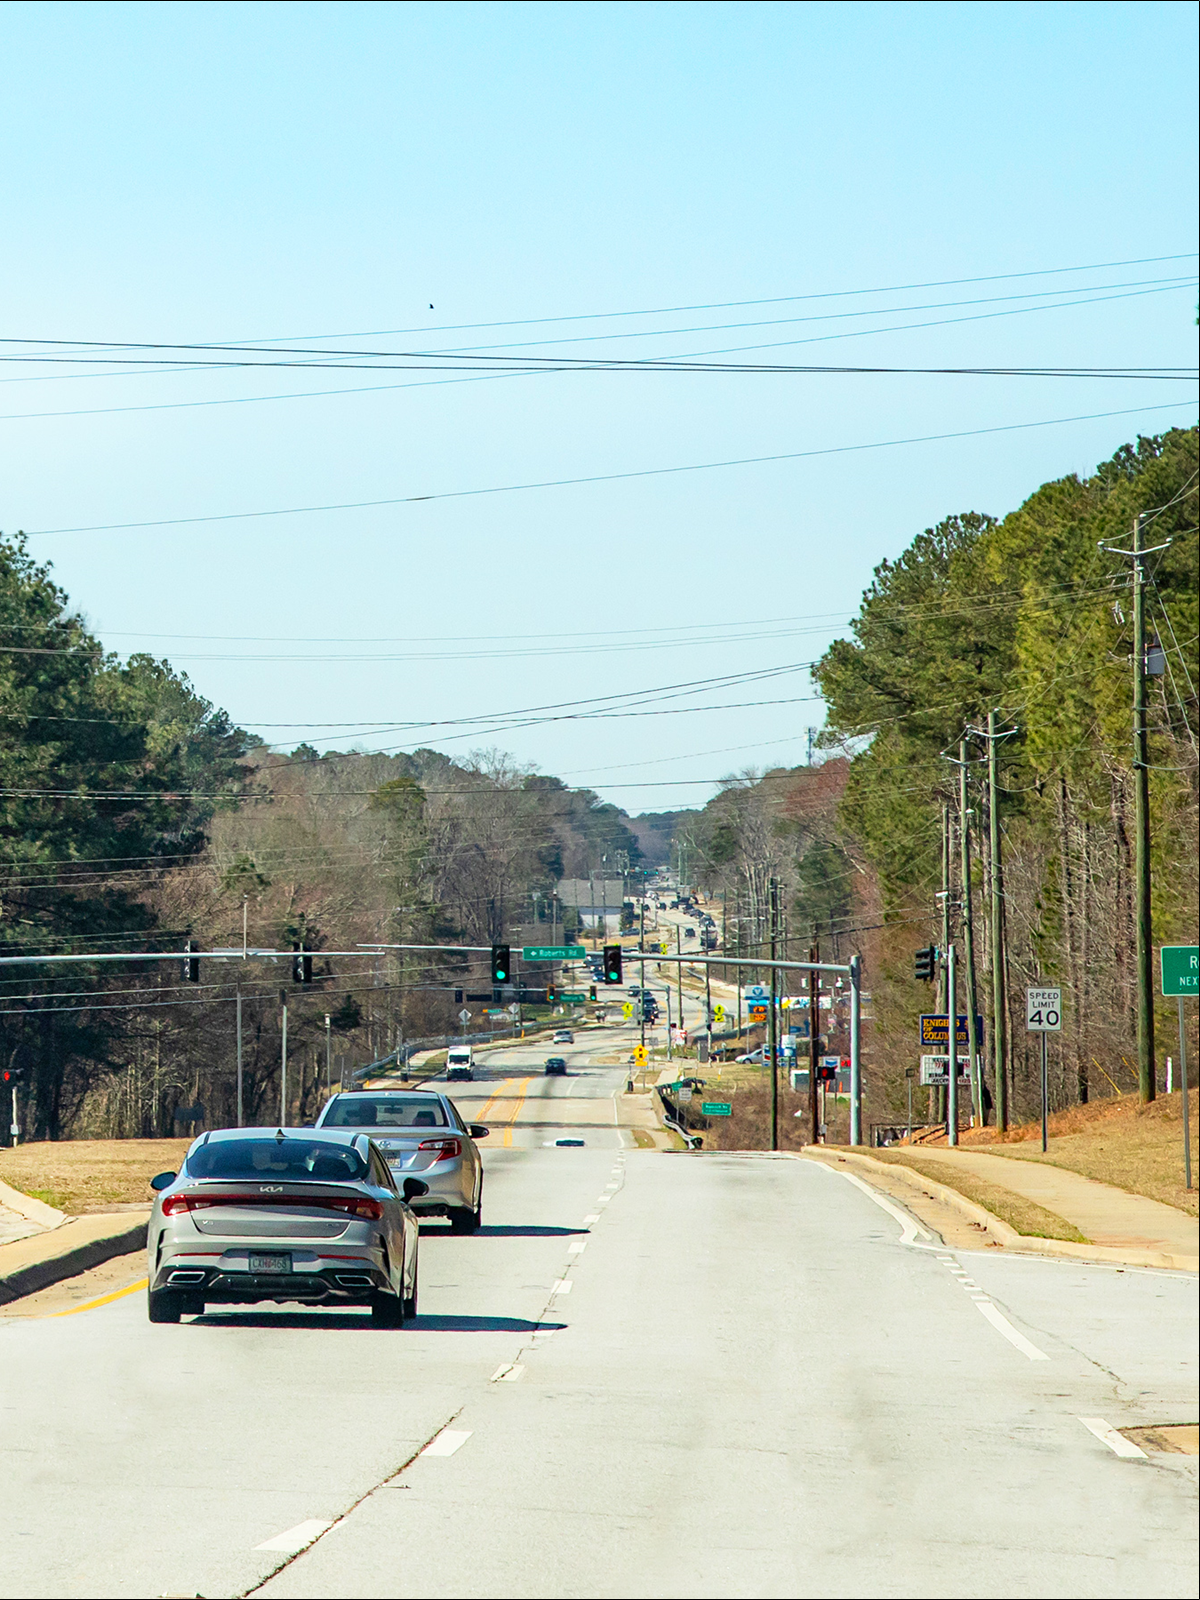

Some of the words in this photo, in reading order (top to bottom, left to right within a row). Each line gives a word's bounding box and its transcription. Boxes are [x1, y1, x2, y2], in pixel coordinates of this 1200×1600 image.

[1190, 955, 1199, 969] R
[1179, 976, 1199, 986] NEX
[923, 1019, 960, 1027] KNIGHS
[1029, 1010, 1059, 1026] 40
[923, 1032, 966, 1040] COLUMUS
